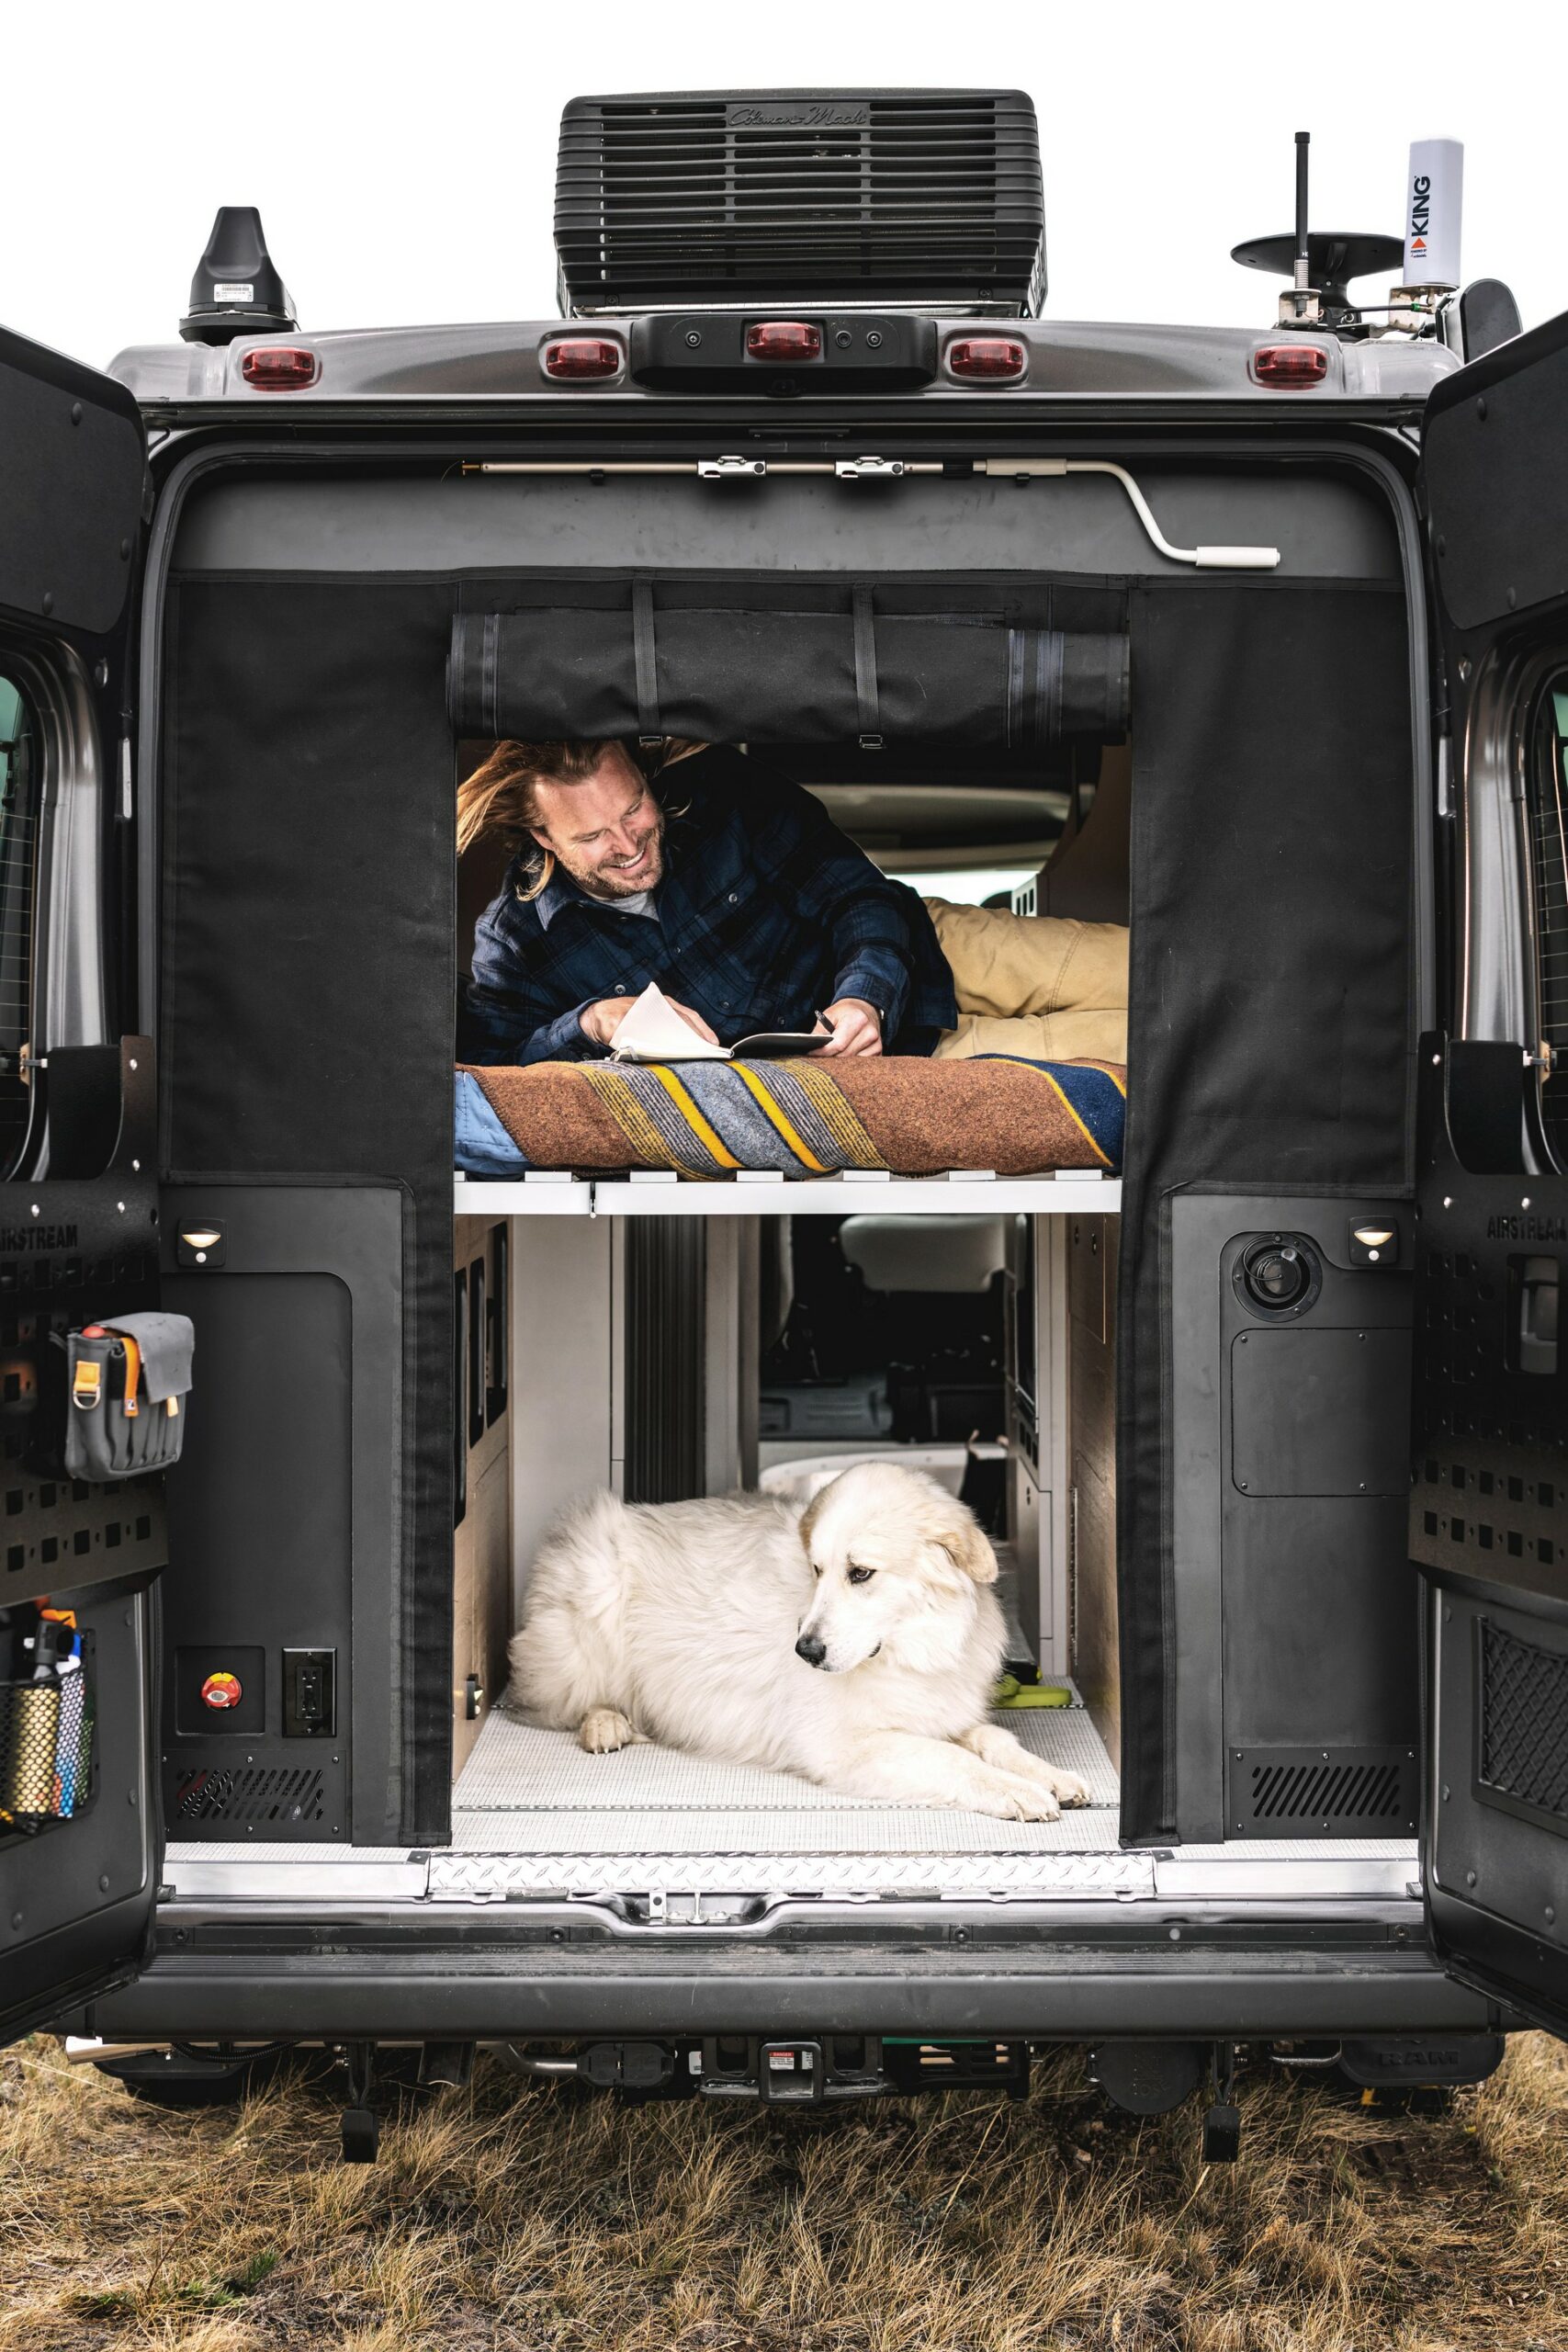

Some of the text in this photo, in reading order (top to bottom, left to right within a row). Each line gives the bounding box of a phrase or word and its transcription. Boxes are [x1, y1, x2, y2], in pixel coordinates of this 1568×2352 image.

[1412, 175, 1431, 237] KING
[0, 1225, 78, 1252] IRSTREAM
[1486, 1216, 1567, 1242] AIRSTREAM
